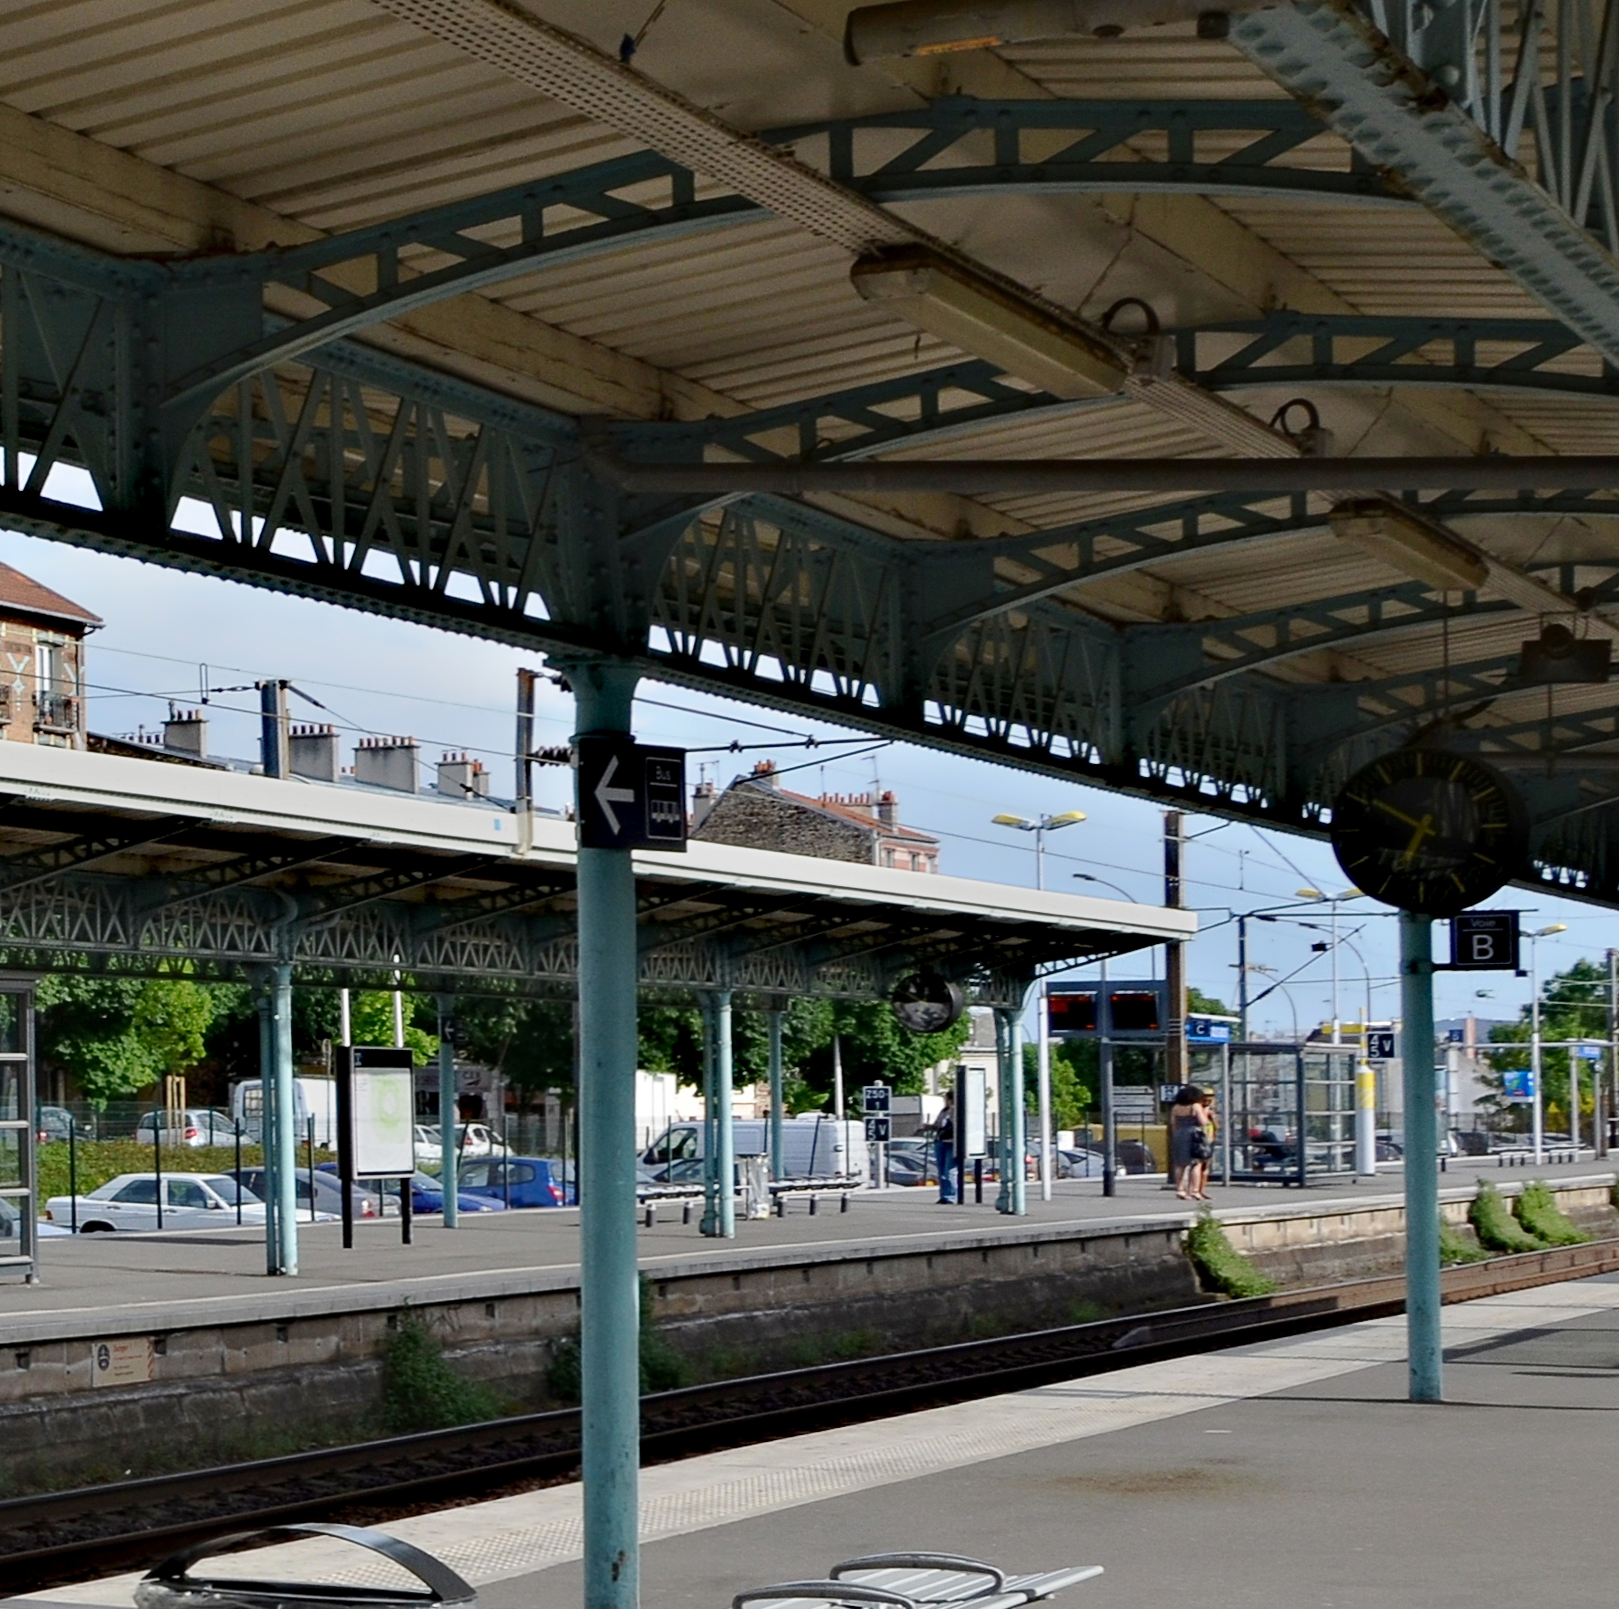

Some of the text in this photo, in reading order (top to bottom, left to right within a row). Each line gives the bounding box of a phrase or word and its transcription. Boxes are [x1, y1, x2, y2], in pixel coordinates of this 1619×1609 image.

[656, 766, 671, 780] Bus
[1471, 918, 1496, 927] Voie
[1472, 934, 1494, 960] B
[1196, 1025, 1205, 1034] C
[1382, 1040, 1392, 1051] V
[1370, 1046, 1379, 1057] 5
[868, 1120, 876, 1129] 4
[878, 1124, 887, 1135] V
[868, 1130, 877, 1141] 5
